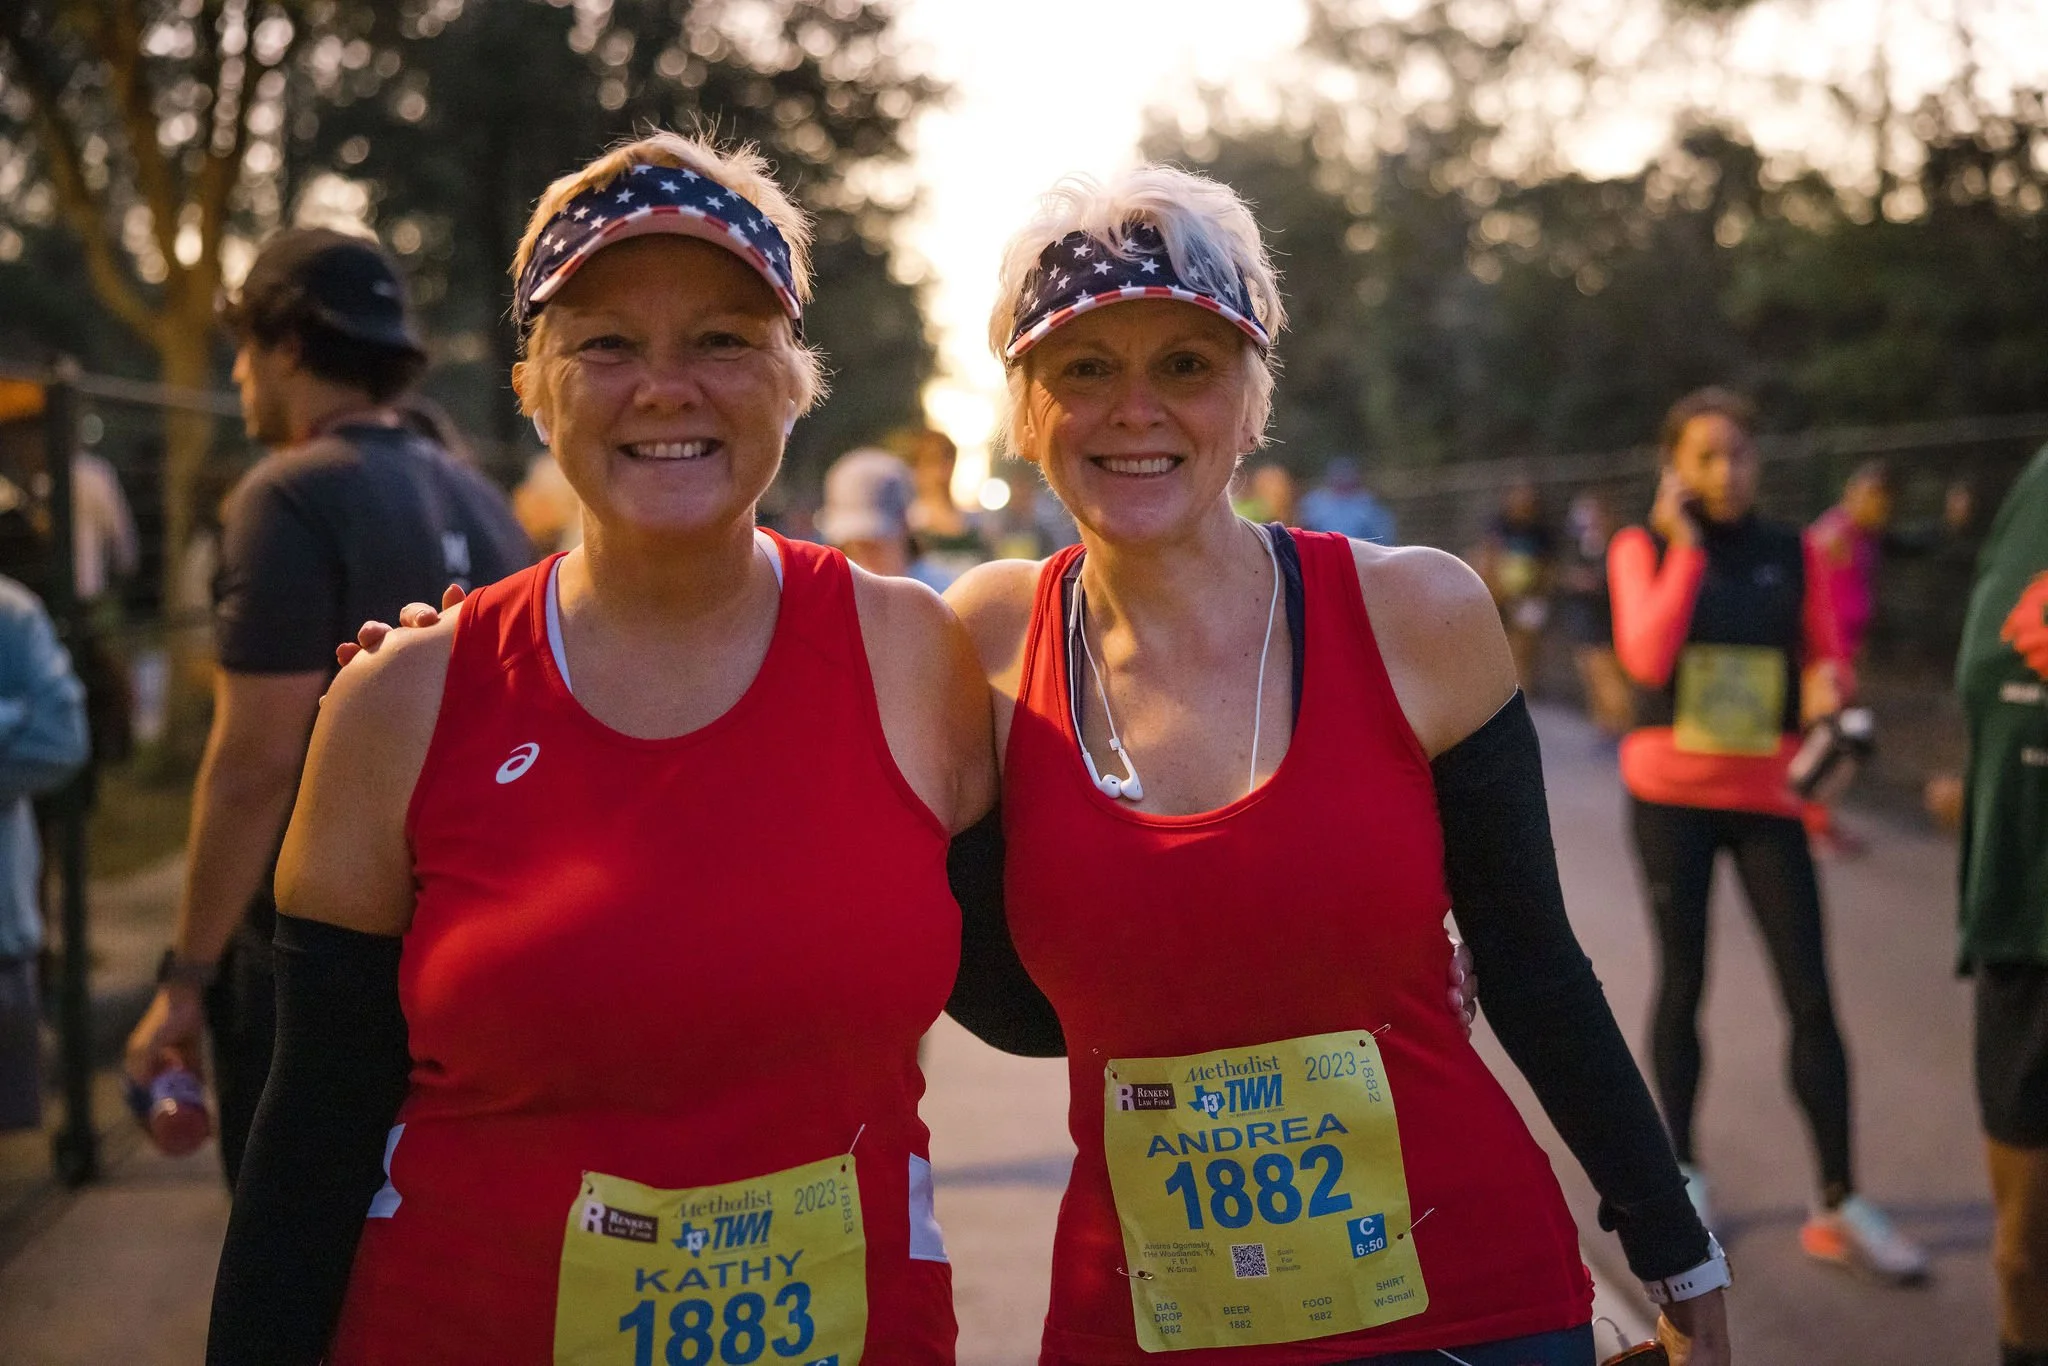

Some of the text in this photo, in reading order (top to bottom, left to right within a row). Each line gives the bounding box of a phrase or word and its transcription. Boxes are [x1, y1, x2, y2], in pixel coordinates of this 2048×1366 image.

[1184, 1055, 1281, 1083] Methodist
[1305, 1051, 1356, 1081] 2023
[1360, 1057, 1381, 1103] 1882
[1117, 1083, 1135, 1111] R
[1224, 1073, 1283, 1112] TWM
[1147, 1113, 1349, 1158] ANDREA
[794, 1179, 837, 1215] 2023
[1165, 1143, 1353, 1229] 1882
[583, 1201, 605, 1234] R
[672, 1190, 772, 1218] Methodist
[840, 1184, 854, 1234] 1883
[713, 1209, 773, 1250] TWM
[1359, 1217, 1375, 1236] C
[1204, 1248, 1216, 1257] TX
[1356, 1237, 1384, 1256] 6:50
[635, 1249, 804, 1292] KATHY
[1376, 1275, 1406, 1291] SHIRT
[1156, 1301, 1178, 1312] BAG
[1223, 1305, 1250, 1315] BEER
[1302, 1296, 1333, 1308] FOOD
[1374, 1289, 1415, 1307] W-Small
[619, 1281, 815, 1366] 1883
[1154, 1312, 1183, 1323] DROP
[1159, 1324, 1182, 1335] 1882
[1229, 1319, 1251, 1329] 1882
[1309, 1311, 1333, 1321] 1882
